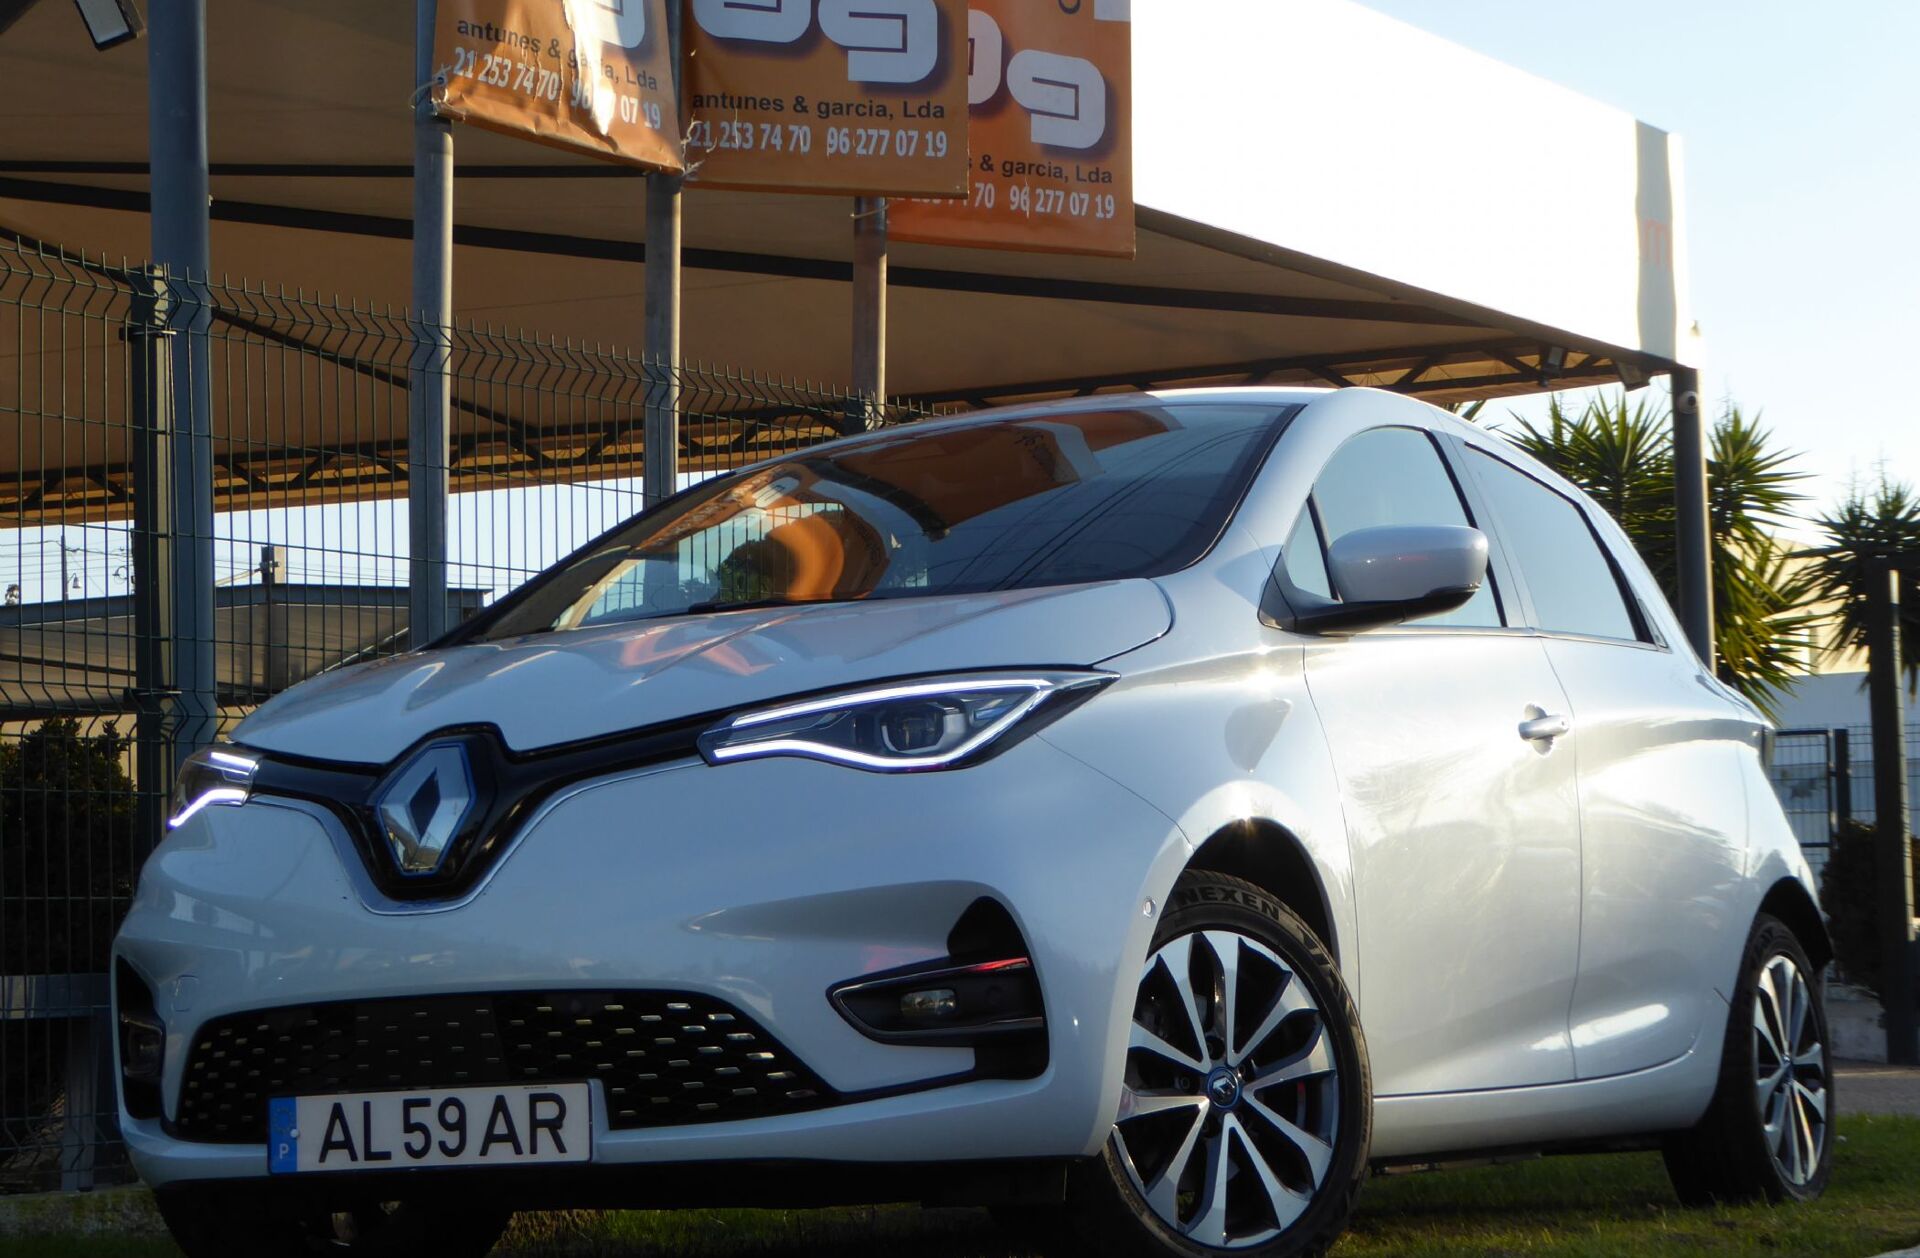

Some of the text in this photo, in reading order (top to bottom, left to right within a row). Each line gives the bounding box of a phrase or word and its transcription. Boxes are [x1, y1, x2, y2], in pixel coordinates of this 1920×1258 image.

[457, 19, 541, 53] antunes
[547, 38, 561, 59] &
[625, 65, 657, 91] Lda
[453, 47, 475, 79] 21
[478, 53, 512, 88] 253
[512, 62, 535, 95] 74
[537, 69, 560, 101] 70
[620, 95, 639, 124] 07
[643, 101, 661, 129] 19
[692, 92, 945, 120] antunes & garcia, Lda
[690, 121, 948, 158] 21 253 74 70 96 277 07 19
[980, 154, 995, 172] &
[1002, 160, 1068, 183] garcia,
[1076, 165, 1113, 184] Lda
[974, 182, 1115, 219] 70 96 277 07 19
[1177, 886, 1280, 921] NEXEN
[279, 1143, 289, 1159] P
